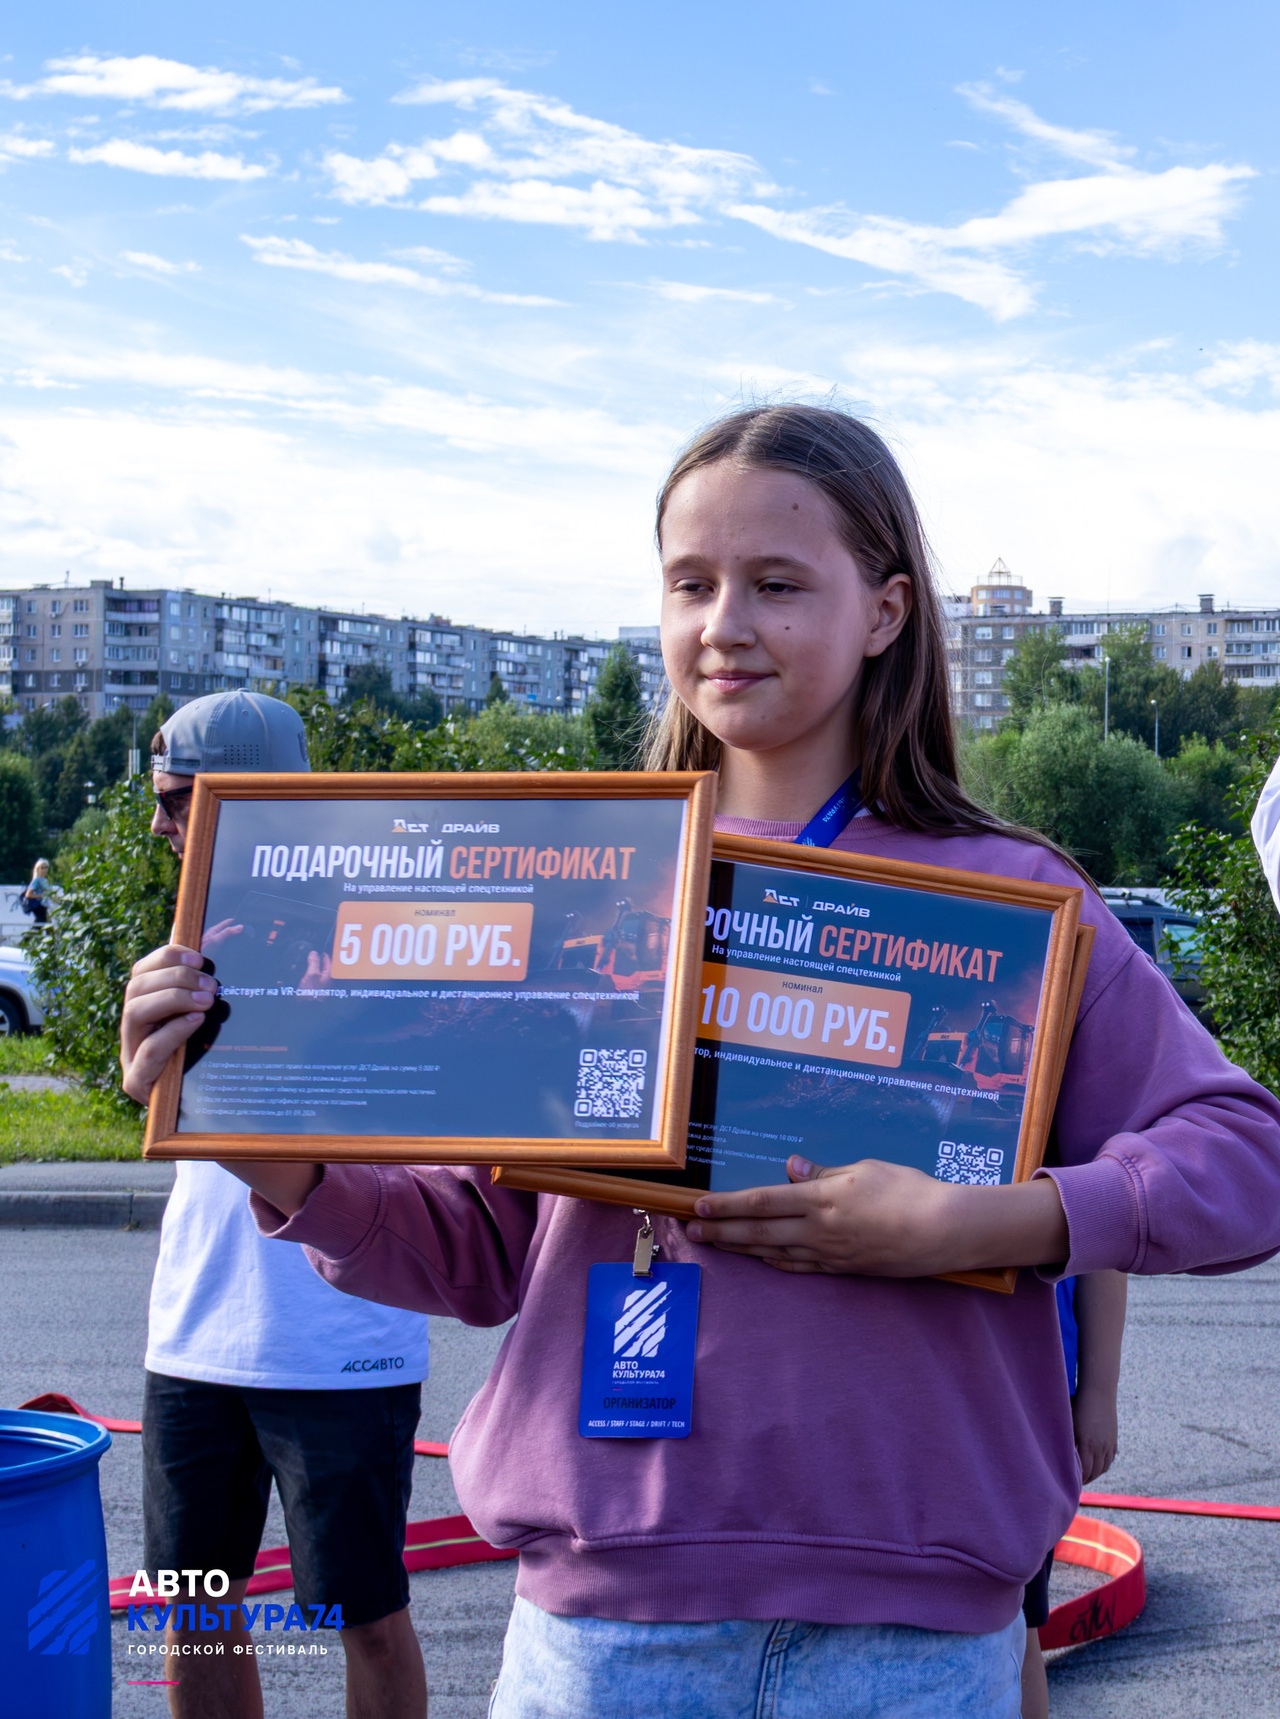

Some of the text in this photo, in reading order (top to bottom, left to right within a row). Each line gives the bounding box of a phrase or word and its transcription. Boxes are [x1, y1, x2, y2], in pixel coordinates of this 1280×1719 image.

[441, 820, 500, 833] ДРАЙВ
[251, 838, 636, 881] ПОДАРОЧНЫЙ СЕРТИФИКАТ
[343, 883, 534, 895] На управление настоящей спецтехникой
[812, 902, 871, 918] ДРАЙВ
[339, 923, 521, 967] 5 000 РУБ.
[819, 925, 1003, 982] СЕРТИФИКАТ
[712, 944, 902, 982] На управление настоящей спецтехникой
[266, 988, 278, 996] на
[350, 988, 430, 1000] индивидуальное
[514, 990, 571, 1001] управление
[572, 990, 640, 1001] спецтехникой
[782, 980, 823, 994] номинал
[701, 984, 896, 1053] 10 000 РУБ.
[714, 1050, 793, 1070] индивидуальное
[795, 1063, 801, 1071] и
[802, 1064, 875, 1082] дистанционное
[877, 1075, 933, 1090] управление
[934, 1084, 999, 1101] спецтехникой
[613, 1361, 638, 1370] АВТО
[612, 1370, 665, 1379] КУЛЬТУРА74
[603, 1397, 676, 1410] ОРГАНИЗАТОР
